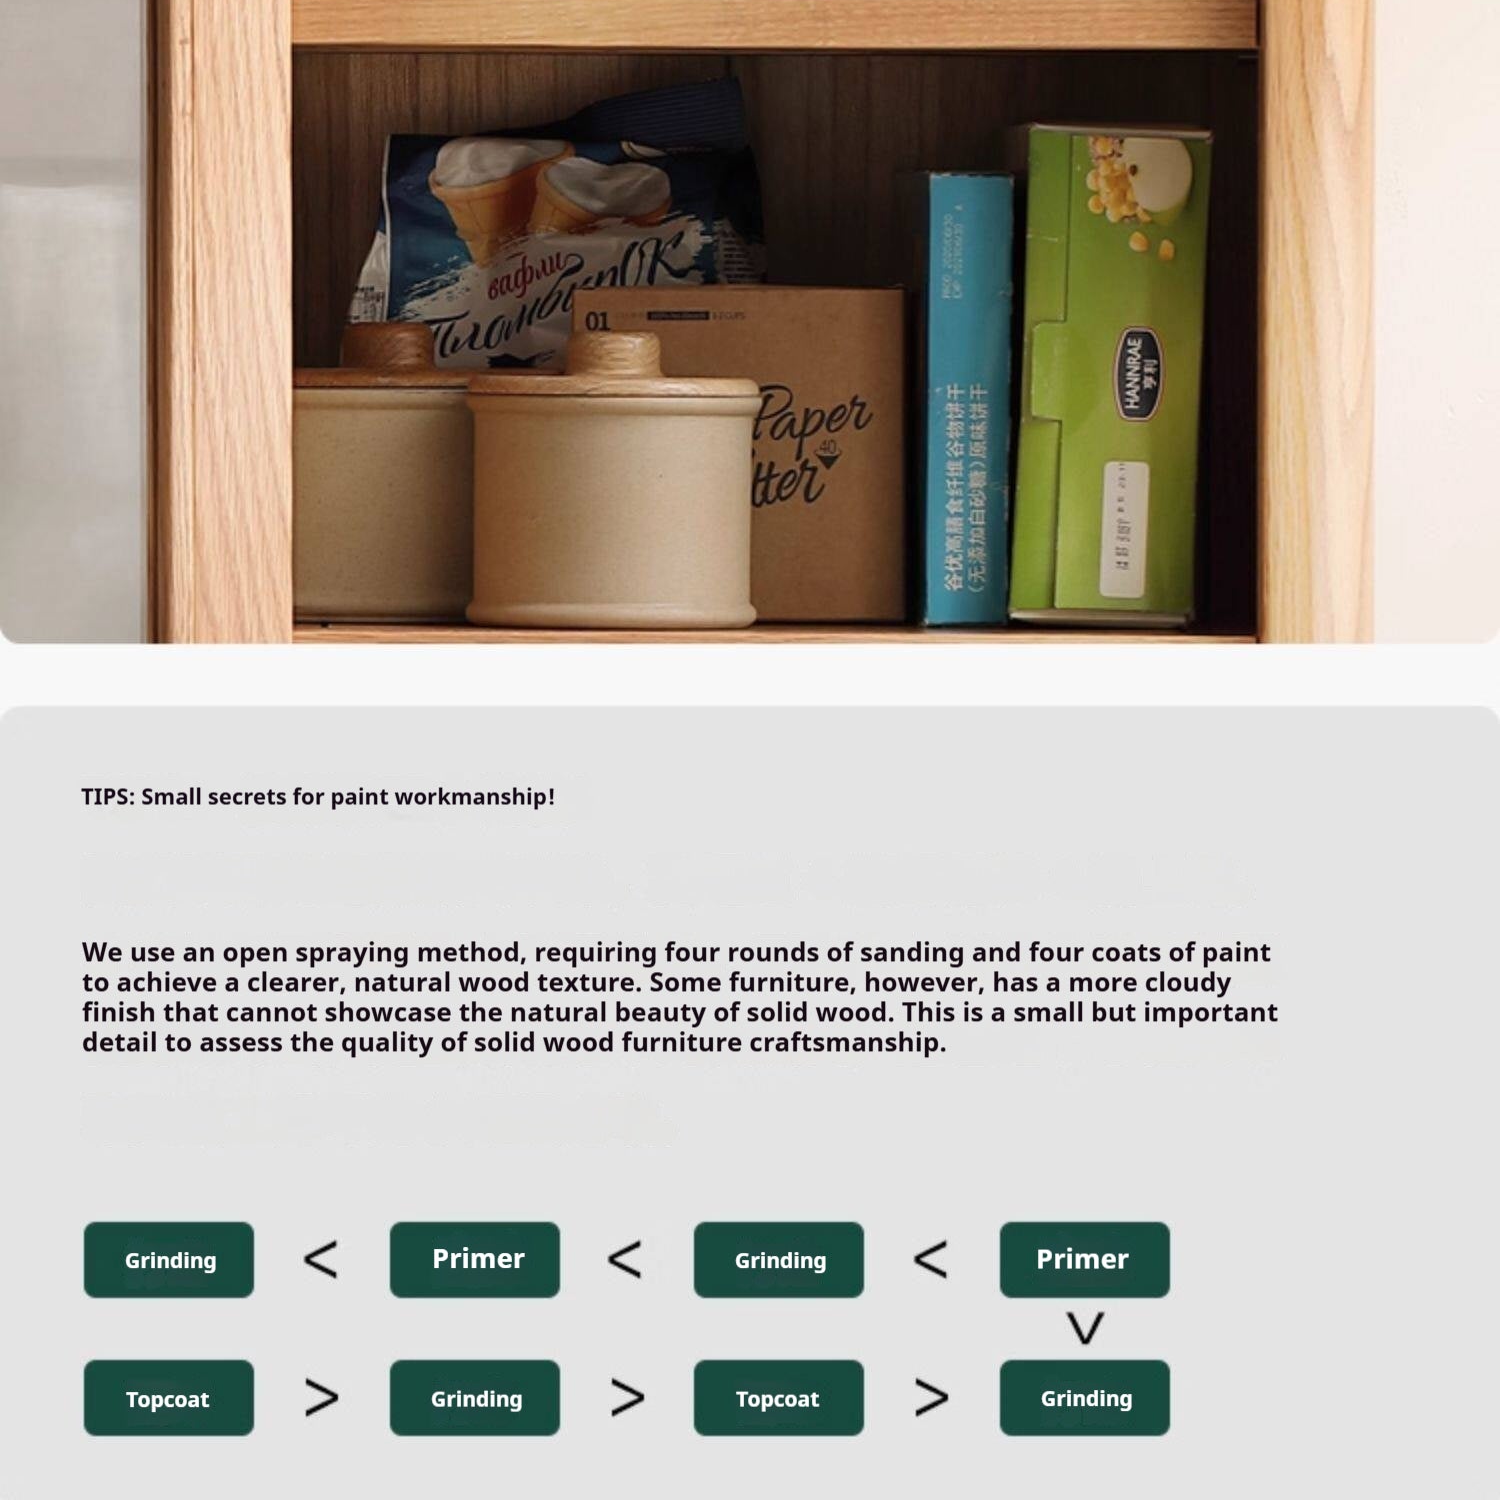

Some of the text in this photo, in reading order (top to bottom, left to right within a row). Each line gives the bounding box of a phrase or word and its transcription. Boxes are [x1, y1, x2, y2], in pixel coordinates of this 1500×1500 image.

[488, 252, 565, 300] вафли
[585, 311, 611, 331] 01
[1125, 337, 1142, 409] HANNRAE
[753, 384, 873, 461] Paper
